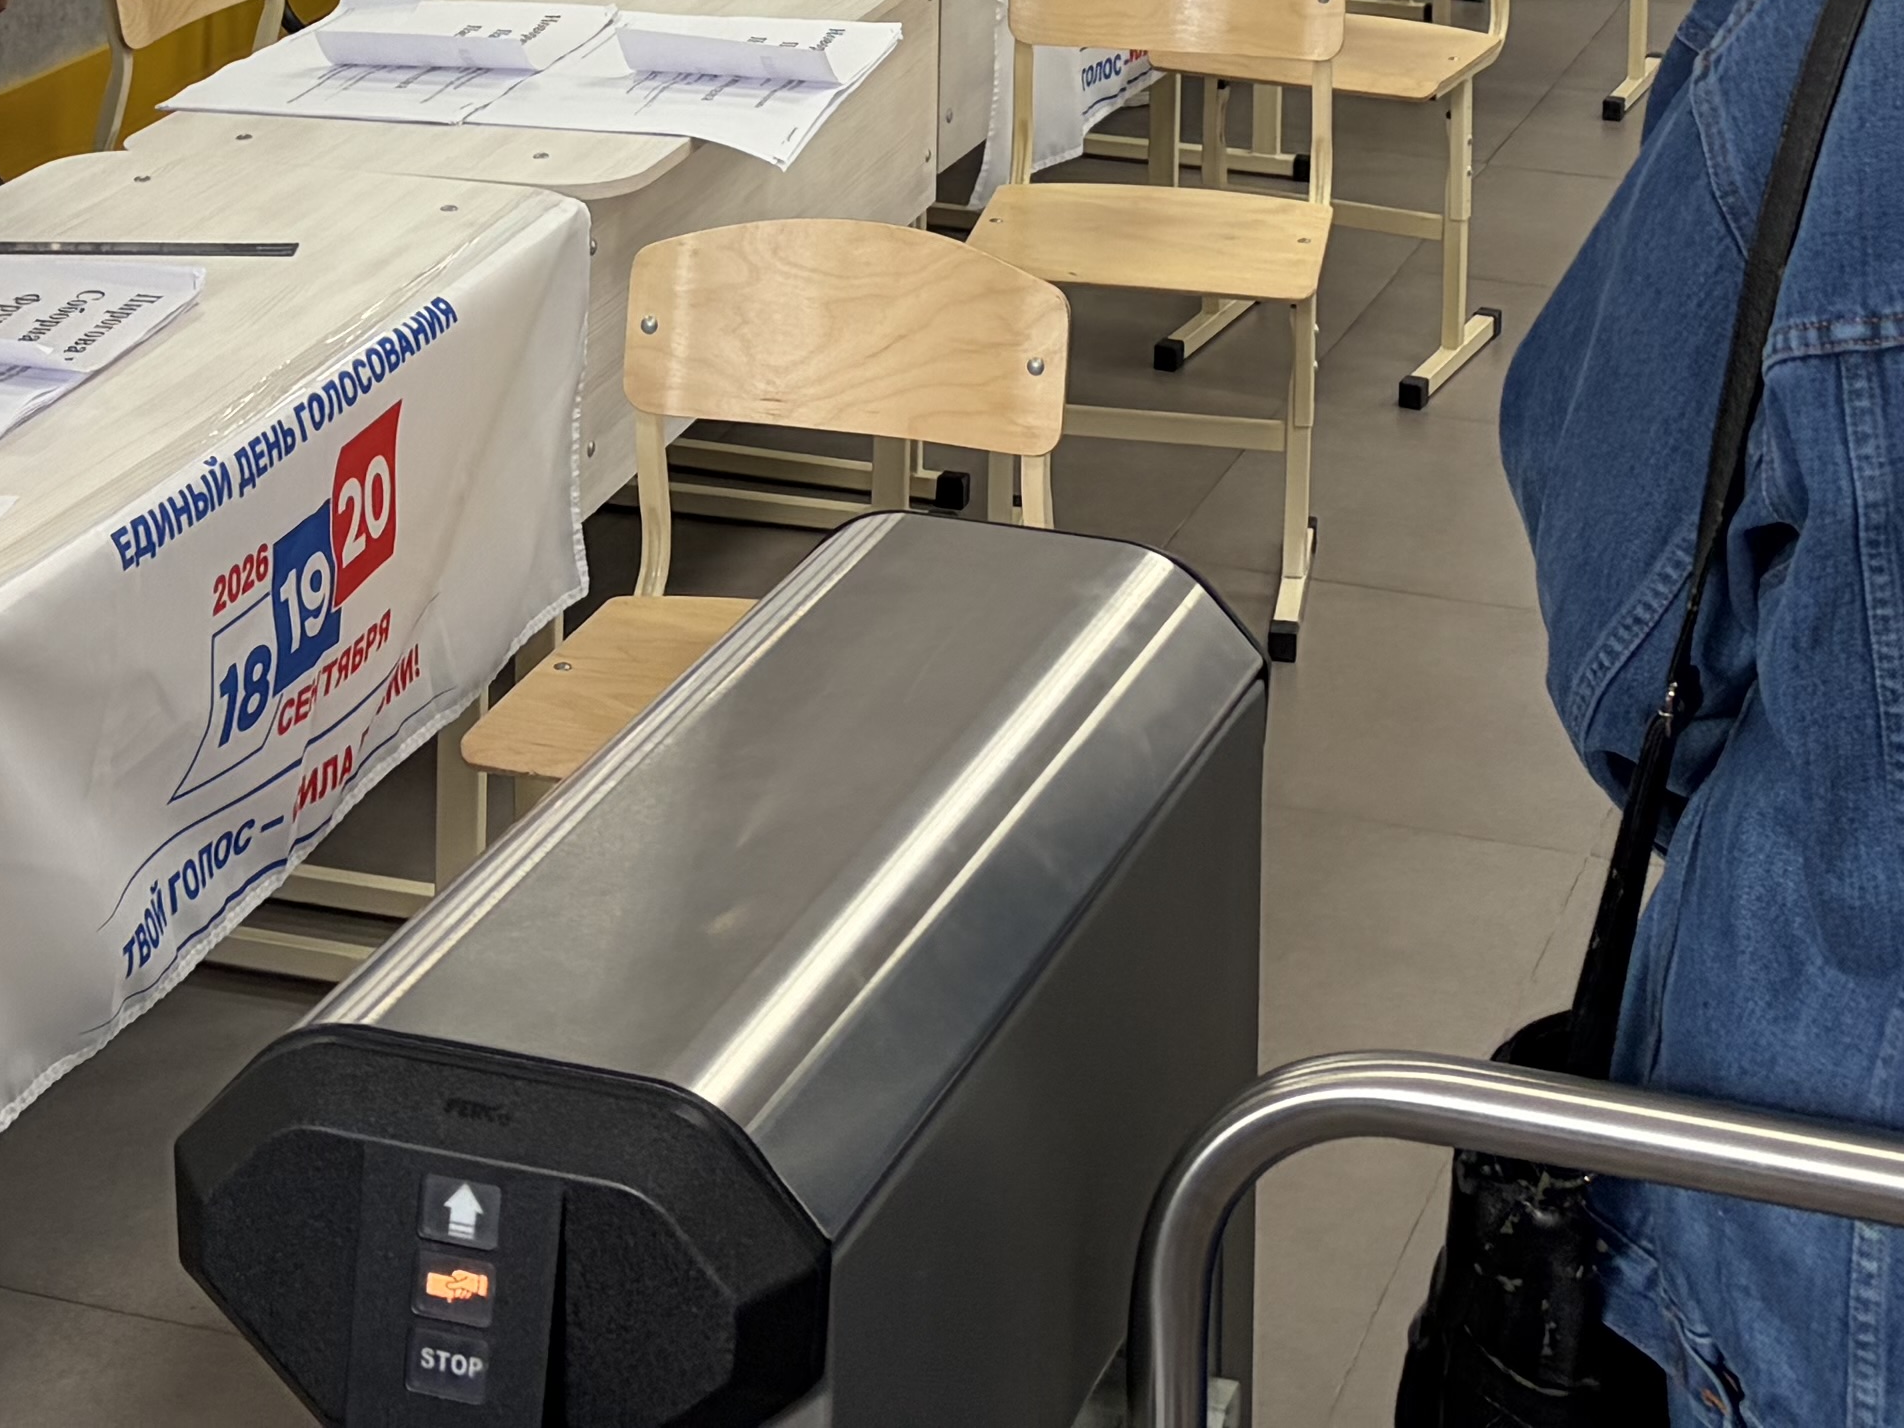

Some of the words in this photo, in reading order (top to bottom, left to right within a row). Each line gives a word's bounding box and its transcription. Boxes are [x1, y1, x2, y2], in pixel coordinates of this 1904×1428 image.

[18, 289, 106, 343] Соборна
[64, 293, 164, 355] Пирогова
[110, 455, 234, 572] ЕДИНЫЙ
[234, 419, 296, 498] ДЕНЬ
[293, 296, 459, 443] ГОЛОСОВАНИЯ
[212, 542, 270, 617] 2026
[218, 643, 273, 748] 18
[279, 550, 331, 655] 19
[337, 454, 391, 570] 20
[277, 608, 392, 737] СЕНТЯБРЯ
[122, 880, 168, 980] ТВОЙ
[168, 818, 256, 916] ГОЛОС
[292, 745, 353, 824] ИЛА
[420, 1347, 483, 1379] STOP
